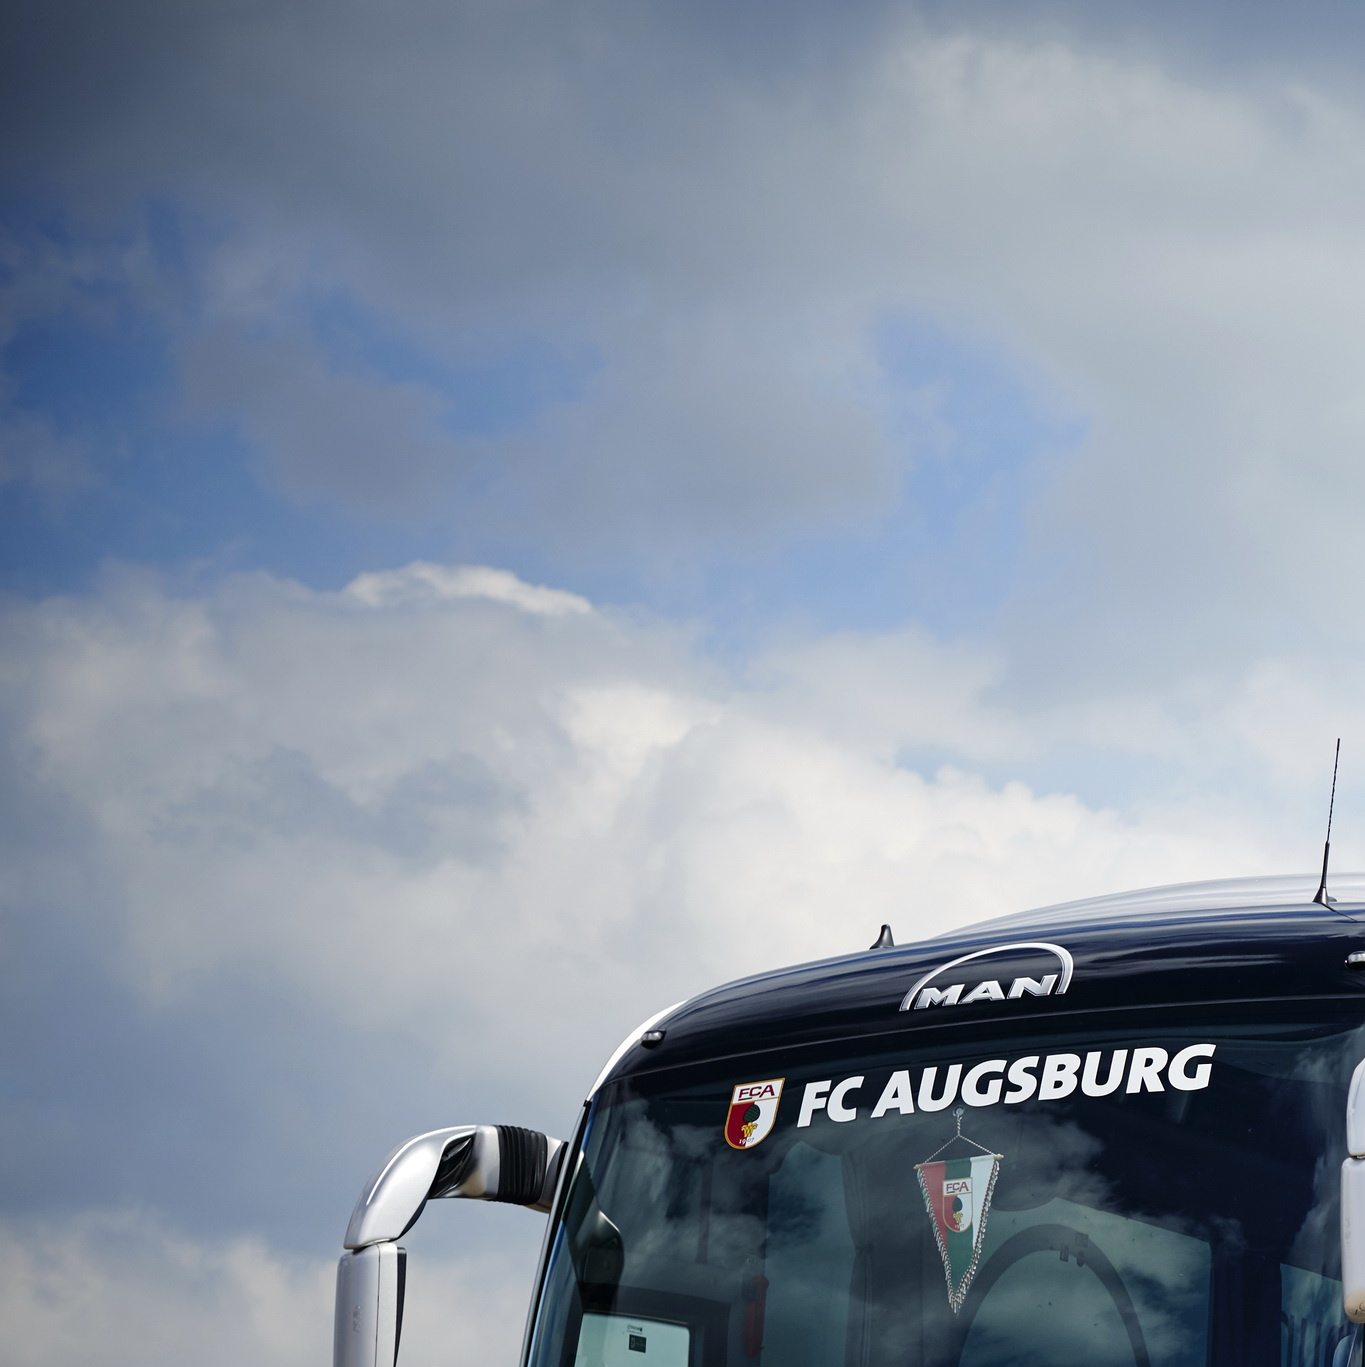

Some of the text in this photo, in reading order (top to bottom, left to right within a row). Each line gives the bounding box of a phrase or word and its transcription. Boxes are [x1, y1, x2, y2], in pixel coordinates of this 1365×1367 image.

[914, 974, 1059, 1010] MAN
[738, 1084, 775, 1099] FCA
[796, 1043, 1217, 1128] FC AUGSBURG
[946, 1181, 969, 1192] FCA
